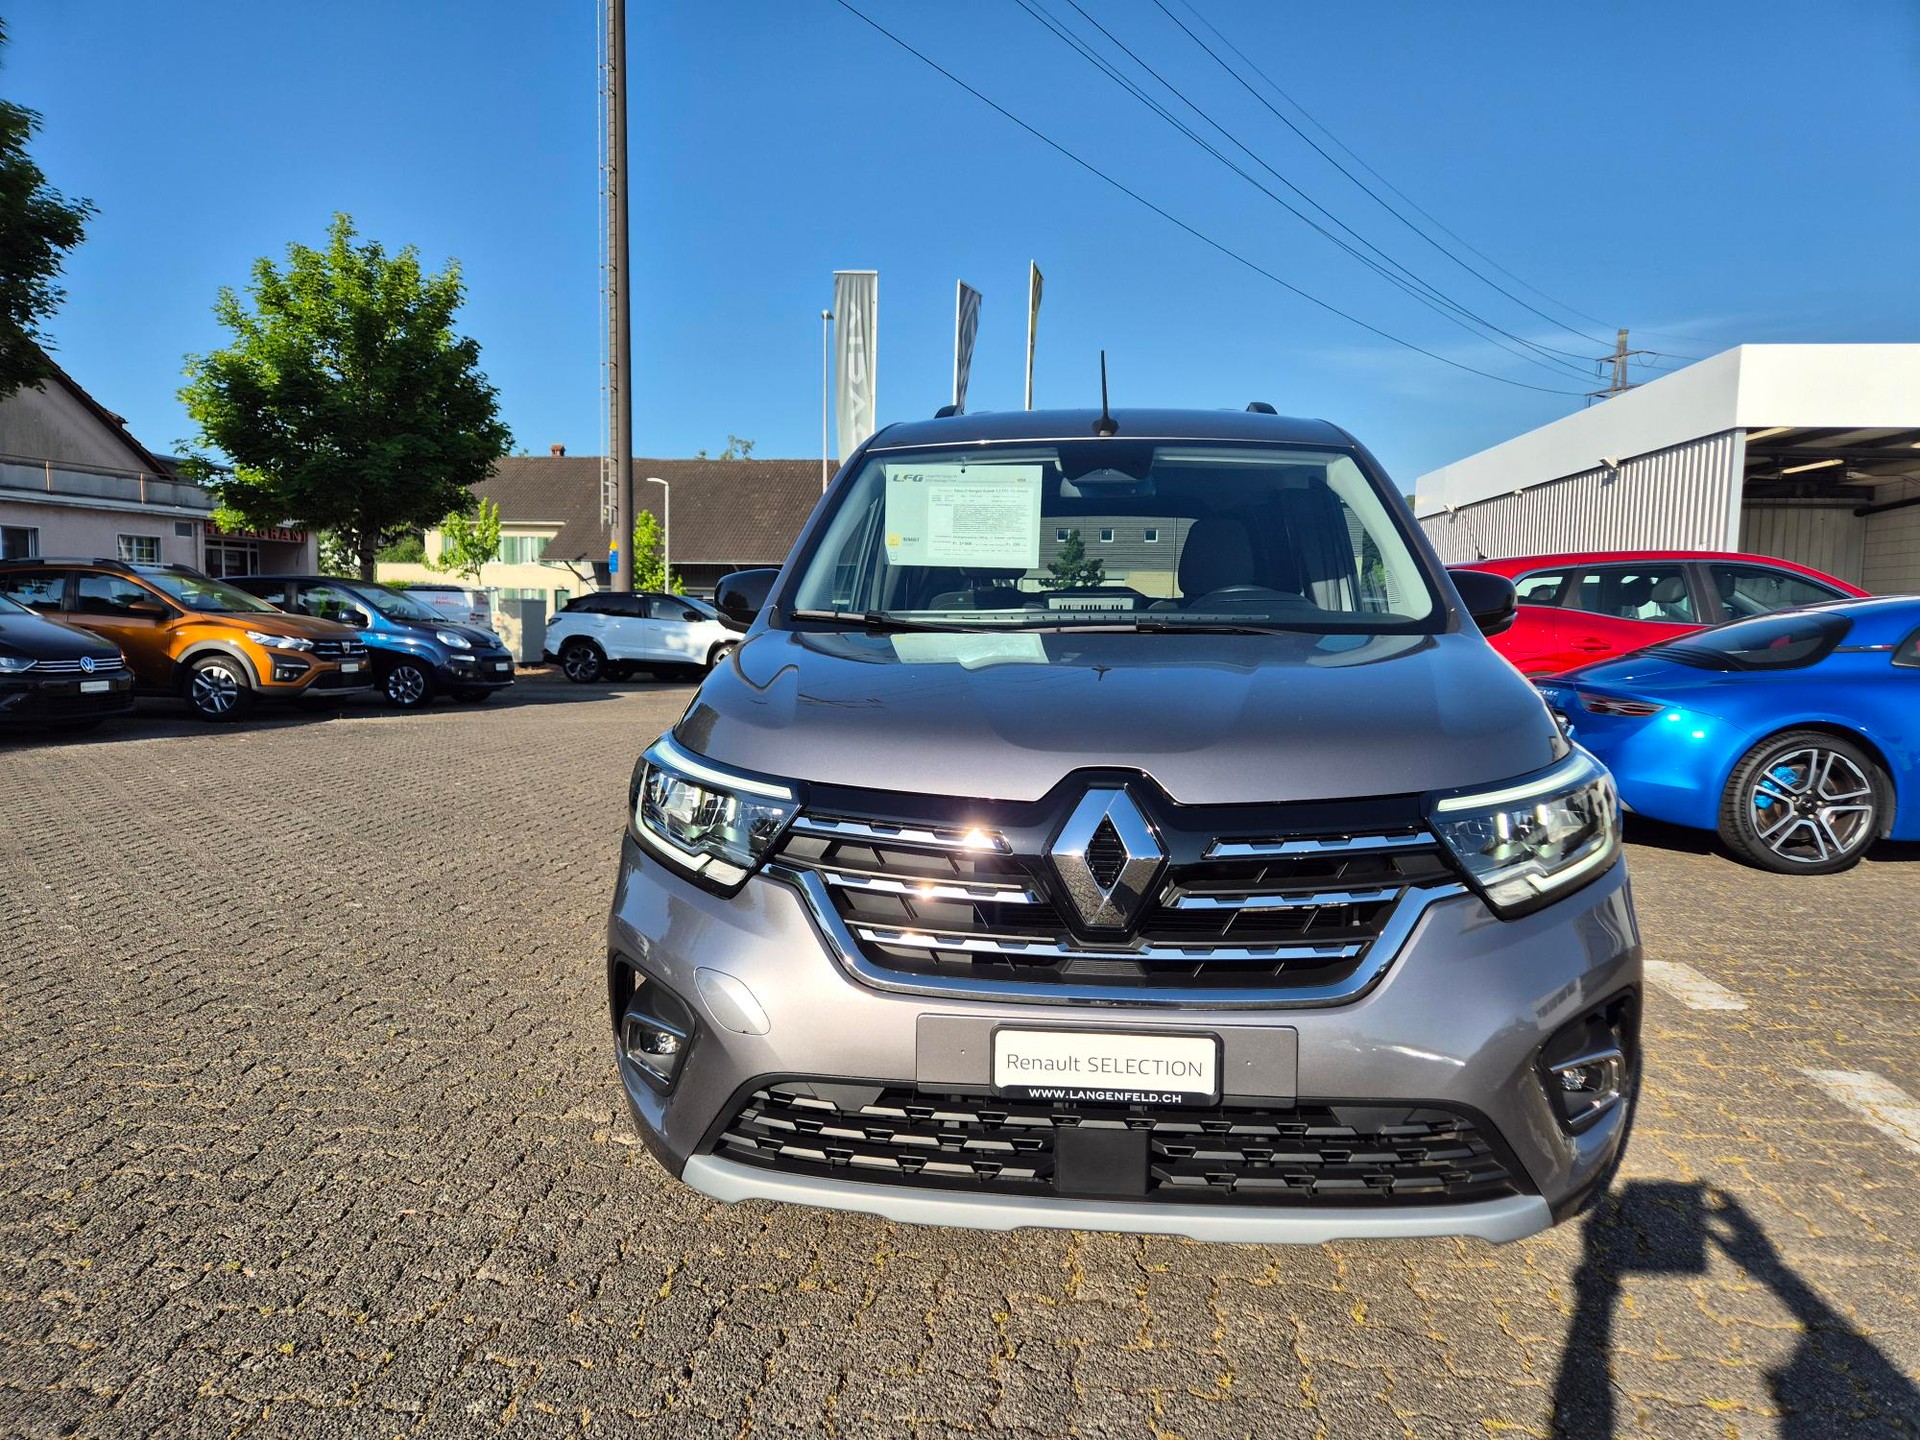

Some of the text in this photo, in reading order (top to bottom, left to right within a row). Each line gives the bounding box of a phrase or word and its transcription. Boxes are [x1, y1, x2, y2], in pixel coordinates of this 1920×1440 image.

[1007, 1053, 1203, 1077] Renault SELECTION
[1029, 1088, 1182, 1104] WWW.LANGENFELD.CH
